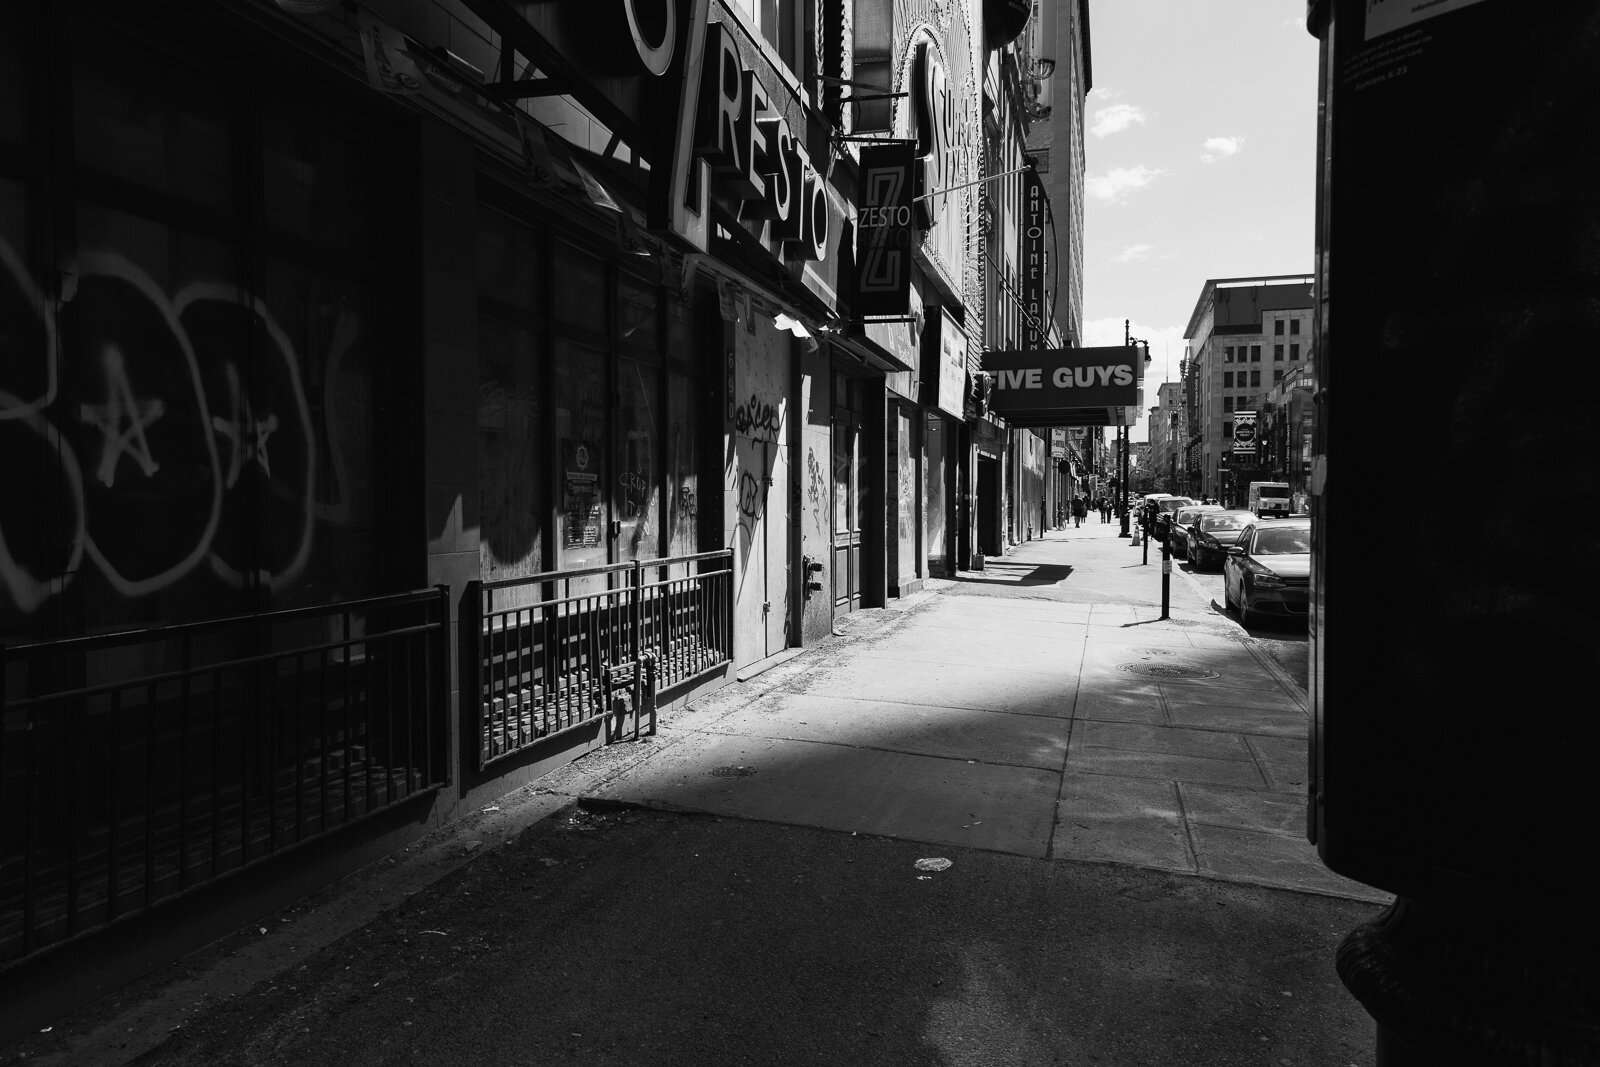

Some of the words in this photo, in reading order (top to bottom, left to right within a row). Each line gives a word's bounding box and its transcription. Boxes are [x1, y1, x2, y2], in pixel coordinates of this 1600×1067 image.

[717, 22, 829, 262] RESTO
[858, 206, 911, 228] ZESTO
[1027, 185, 1042, 280] ANTOINE
[1053, 364, 1133, 388] GUYS
